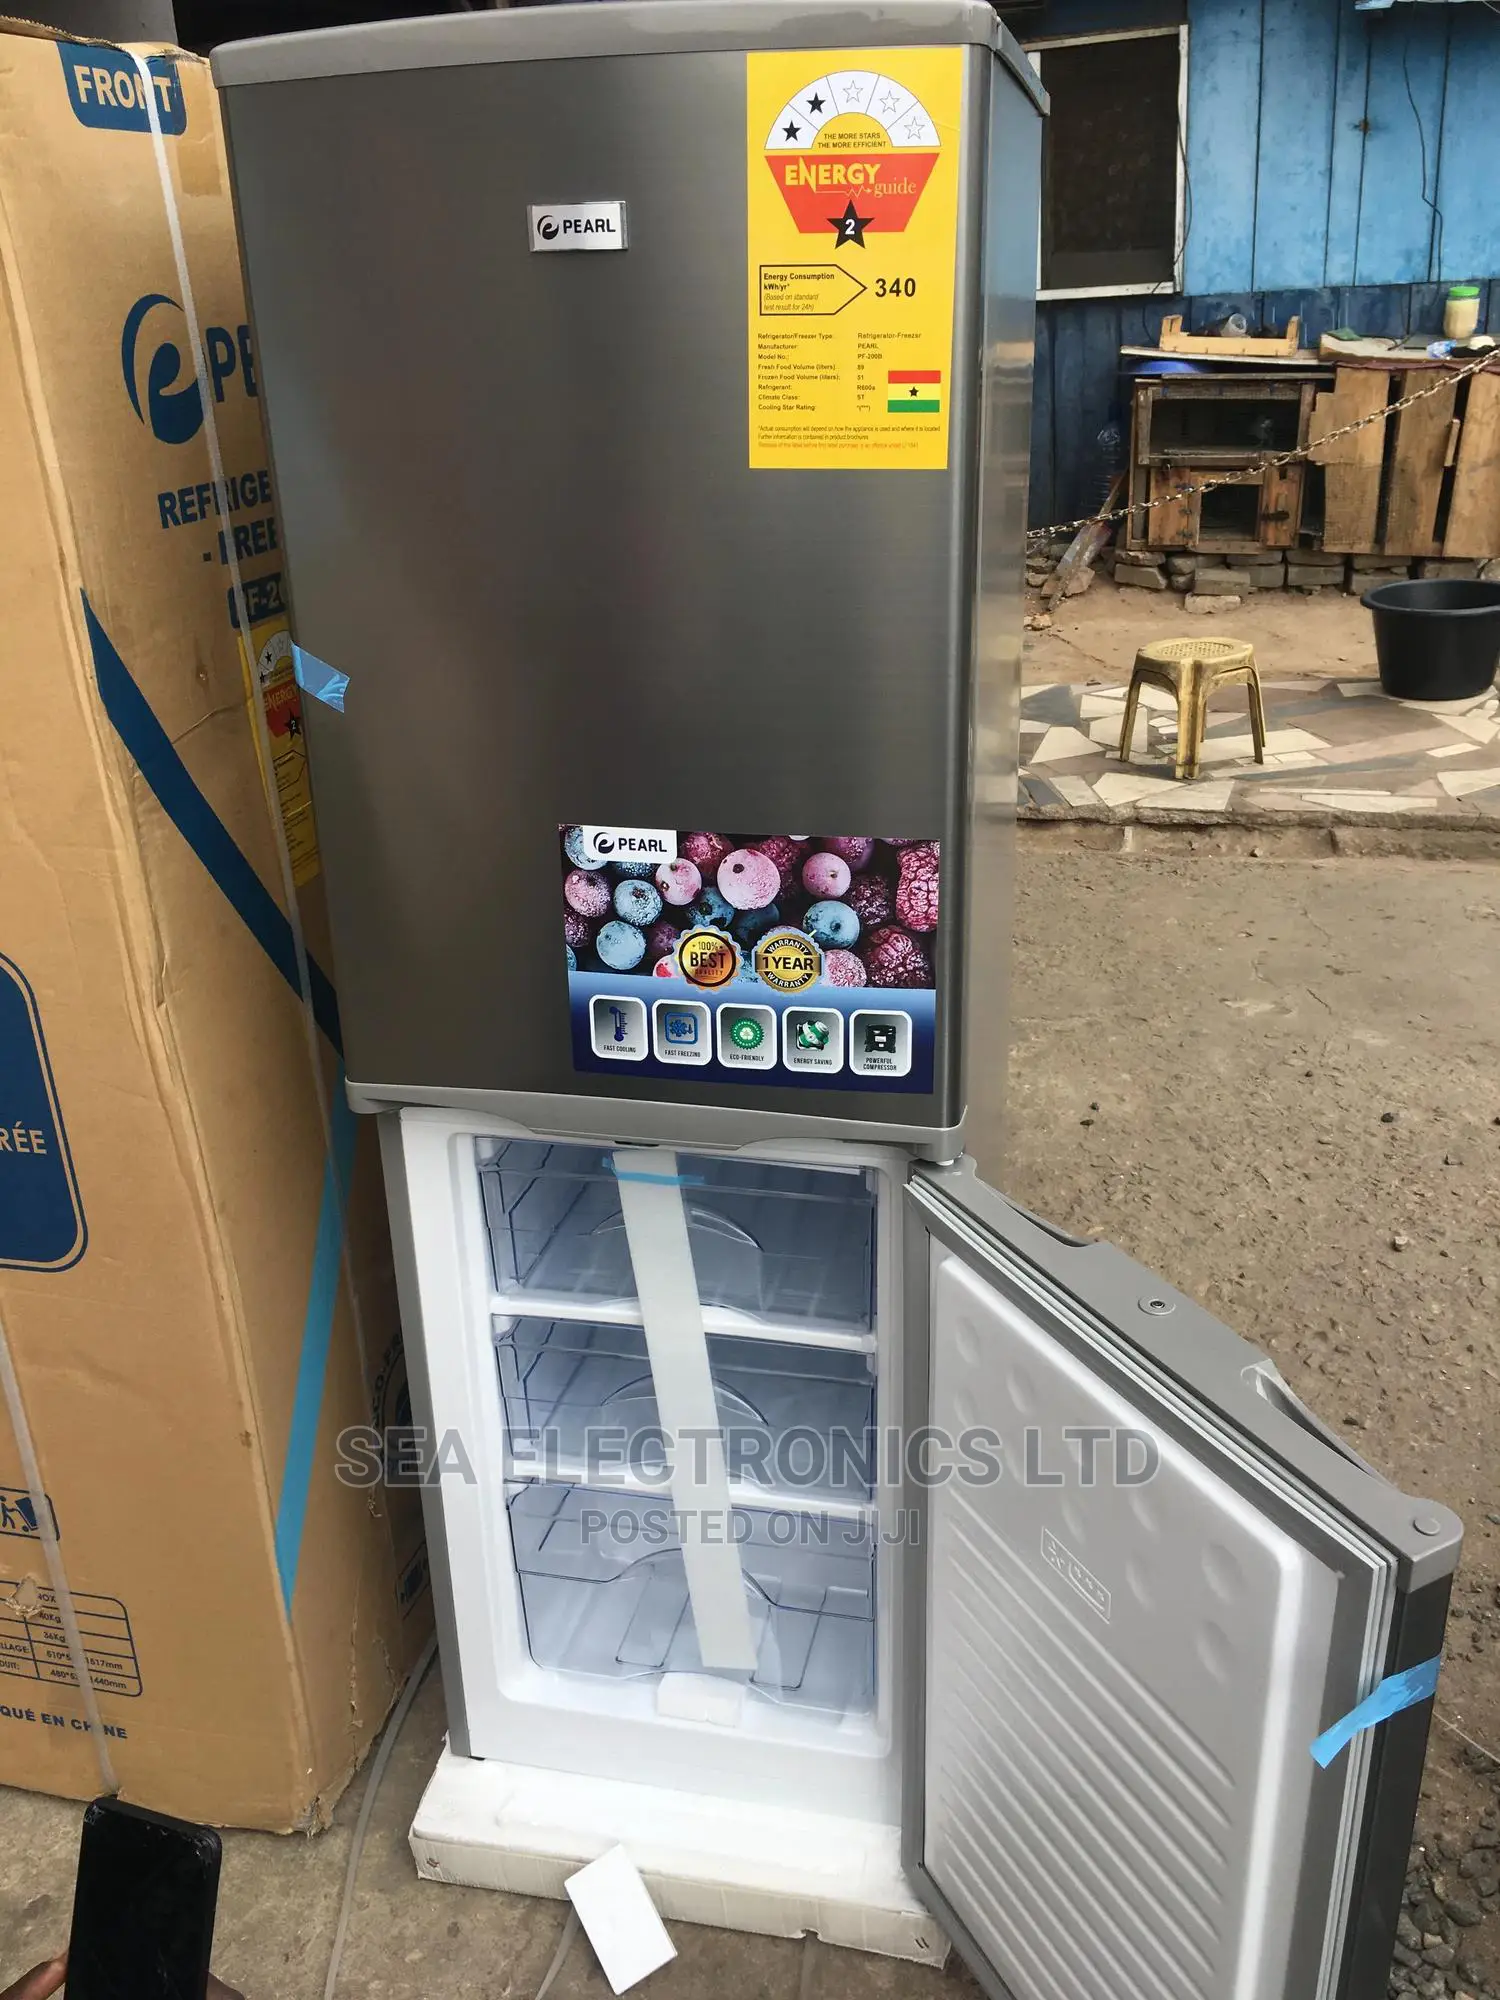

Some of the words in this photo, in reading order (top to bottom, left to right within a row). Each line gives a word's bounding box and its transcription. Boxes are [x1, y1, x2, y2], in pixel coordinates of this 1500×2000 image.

[784, 156, 880, 193] ENERGY
[874, 177, 916, 198] guide
[563, 218, 616, 234] PEARL
[845, 219, 855, 235] 2
[764, 273, 787, 281] Energy
[790, 272, 834, 281] Consumption
[875, 278, 916, 297] 340
[618, 838, 667, 852] PEARL
[698, 941, 718, 950] 100%
[768, 939, 809, 955] WARRANTY
[690, 952, 726, 969] BEST
[772, 957, 814, 970] YEAR
[768, 972, 809, 988] WARRANTY
[616, 1045, 636, 1053] COOLING
[678, 1050, 700, 1058] FREEZING
[729, 1054, 764, 1062] ECO-FRIENDLY
[41, 1712, 65, 1727] EN
